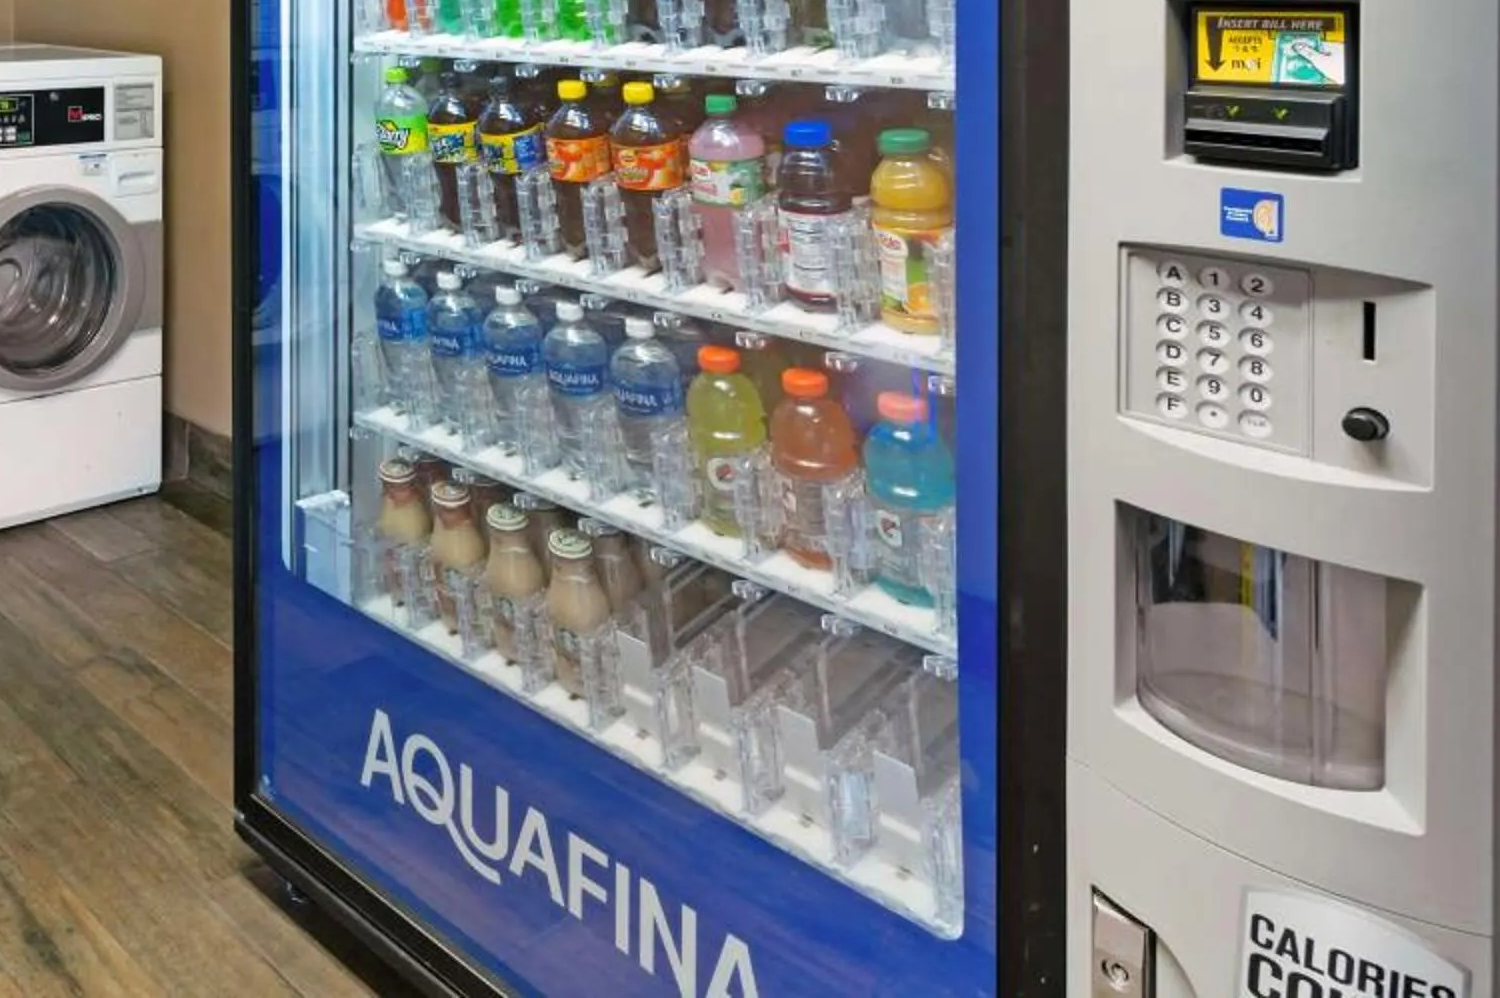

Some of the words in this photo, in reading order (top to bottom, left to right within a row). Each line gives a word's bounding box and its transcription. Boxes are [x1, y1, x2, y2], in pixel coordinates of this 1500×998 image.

[1217, 16, 1257, 29] INSERT
[1167, 266, 1182, 281] A
[1209, 273, 1219, 287] 1
[1251, 279, 1264, 292] 2
[1167, 293, 1181, 307] B
[1208, 300, 1221, 313] 3
[1251, 306, 1263, 320] 4
[1166, 319, 1181, 333] C
[1209, 326, 1221, 340] 5
[1251, 334, 1263, 348] 6
[1167, 346, 1181, 359] D
[1209, 354, 1220, 367] 7
[1251, 361, 1263, 375] 8
[1167, 372, 1180, 385] E
[1208, 379, 1220, 394] 9
[360, 708, 760, 998] AQUAFINA
